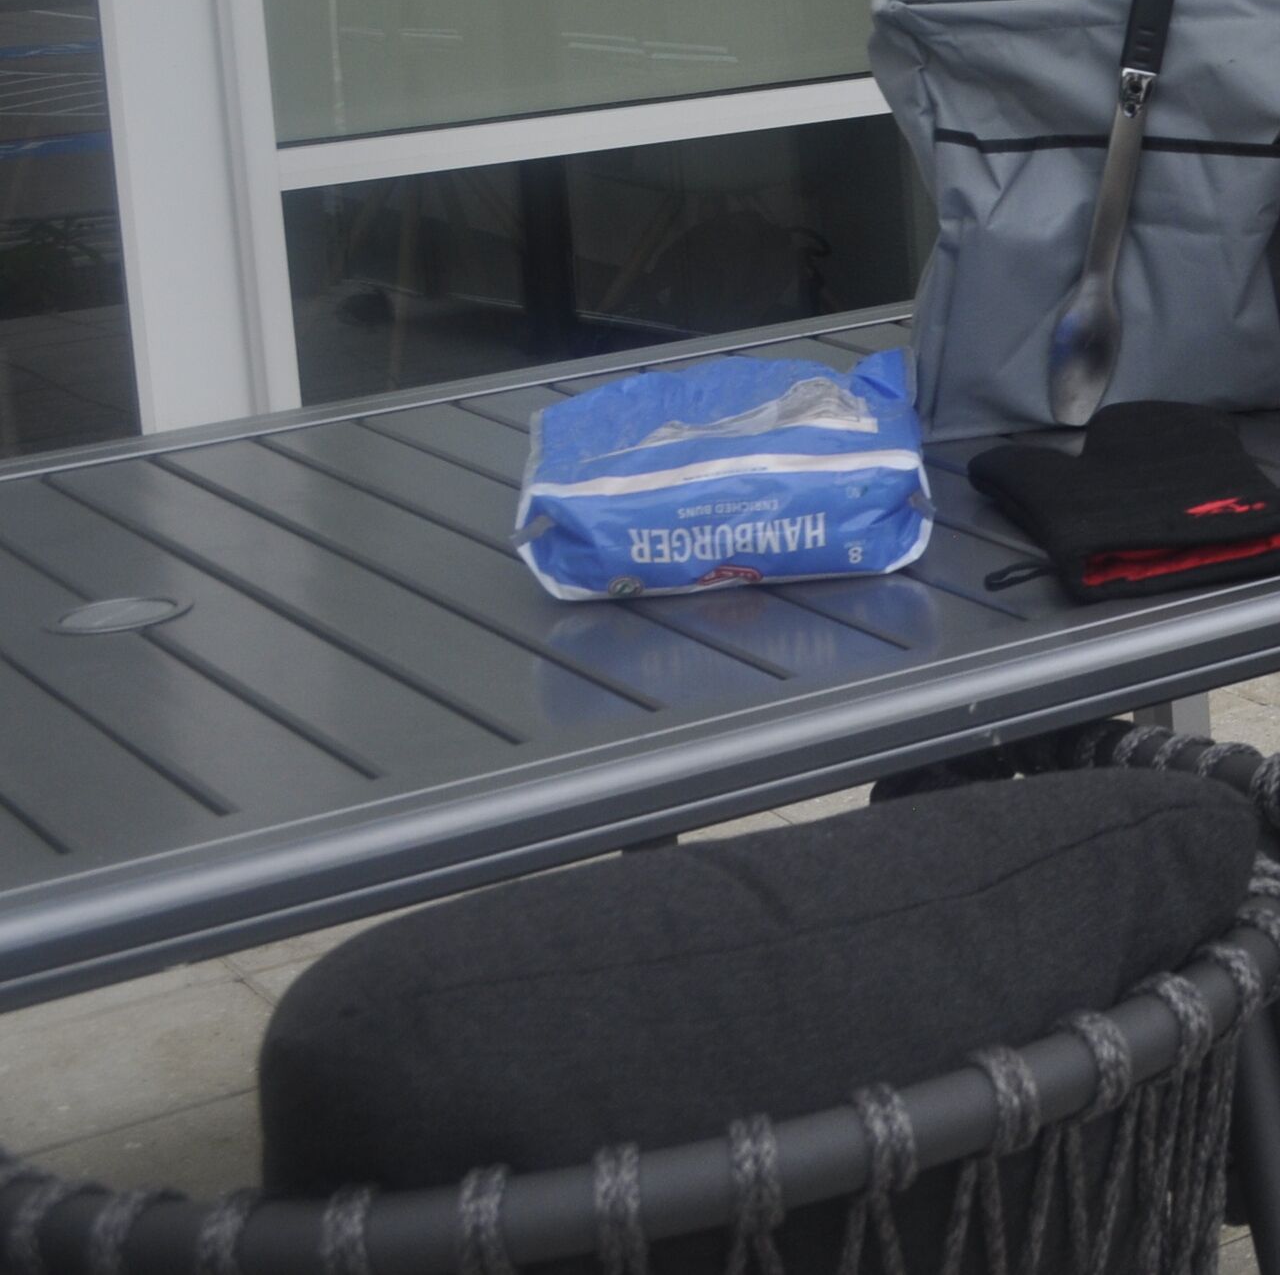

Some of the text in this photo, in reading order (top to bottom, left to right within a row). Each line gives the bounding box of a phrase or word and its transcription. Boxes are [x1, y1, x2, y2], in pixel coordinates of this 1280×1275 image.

[677, 498, 779, 519] ENRICHED BUNS
[628, 512, 826, 563] HAMBURGER
[848, 546, 864, 564] 8
